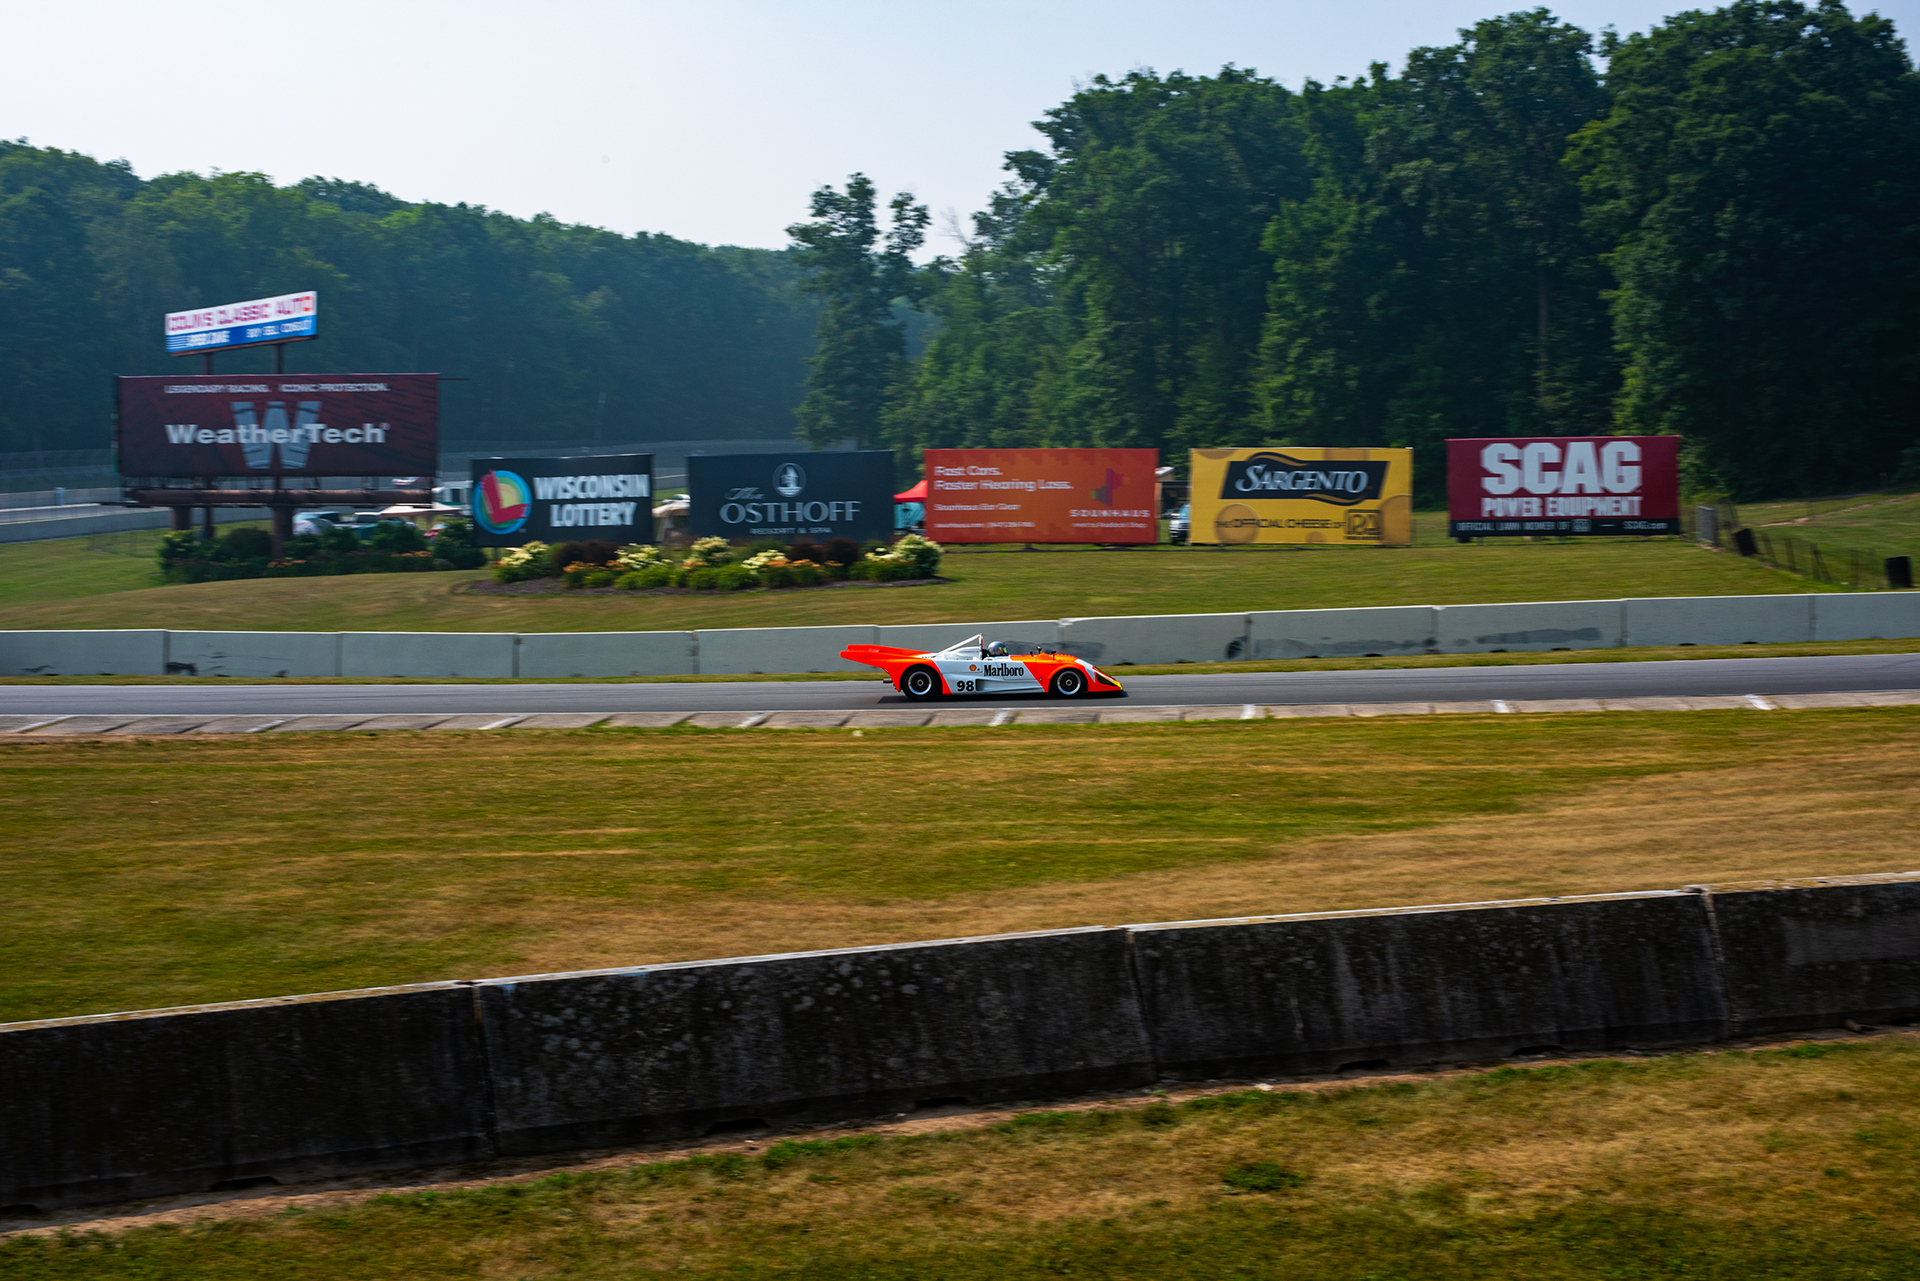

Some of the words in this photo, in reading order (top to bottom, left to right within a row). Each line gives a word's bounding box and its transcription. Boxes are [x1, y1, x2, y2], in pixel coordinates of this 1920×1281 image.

[217, 303, 271, 325] CLASSIC
[274, 296, 315, 315] AUTO
[164, 385, 225, 394] LEGENDARY
[278, 384, 319, 393] ICONIC
[164, 423, 387, 444] WeatherTech
[934, 466, 967, 476] Fast
[967, 466, 1003, 476] Cars.
[1480, 441, 1643, 495] SCAG
[532, 474, 650, 500] WISCONSIN
[934, 480, 980, 490] Faster
[980, 478, 1037, 492] Hearing
[1037, 479, 1074, 490] Loss.
[724, 487, 766, 500] The
[719, 500, 862, 524] OSTHOFF
[933, 503, 981, 511] Sounhaus
[981, 503, 997, 511] Ear
[997, 503, 1021, 511] Gear
[1068, 509, 1151, 518] SOUNHAUS
[1481, 497, 1544, 518] POWER
[1544, 496, 1643, 517] EQUIPMENT
[550, 501, 638, 527] LOTTERY
[1230, 518, 1284, 528] OFFICIAL
[1284, 518, 1333, 528] CHEESE
[1456, 521, 1496, 531] OFFICIAL
[1496, 521, 1522, 531] LAWN
[1522, 521, 1556, 531] MOWER
[1556, 521, 1571, 531] OF
[1622, 521, 1669, 530] SCAG.com
[749, 527, 796, 535] RESORT
[983, 663, 1024, 677] Marlboro
[956, 680, 974, 692] 98
